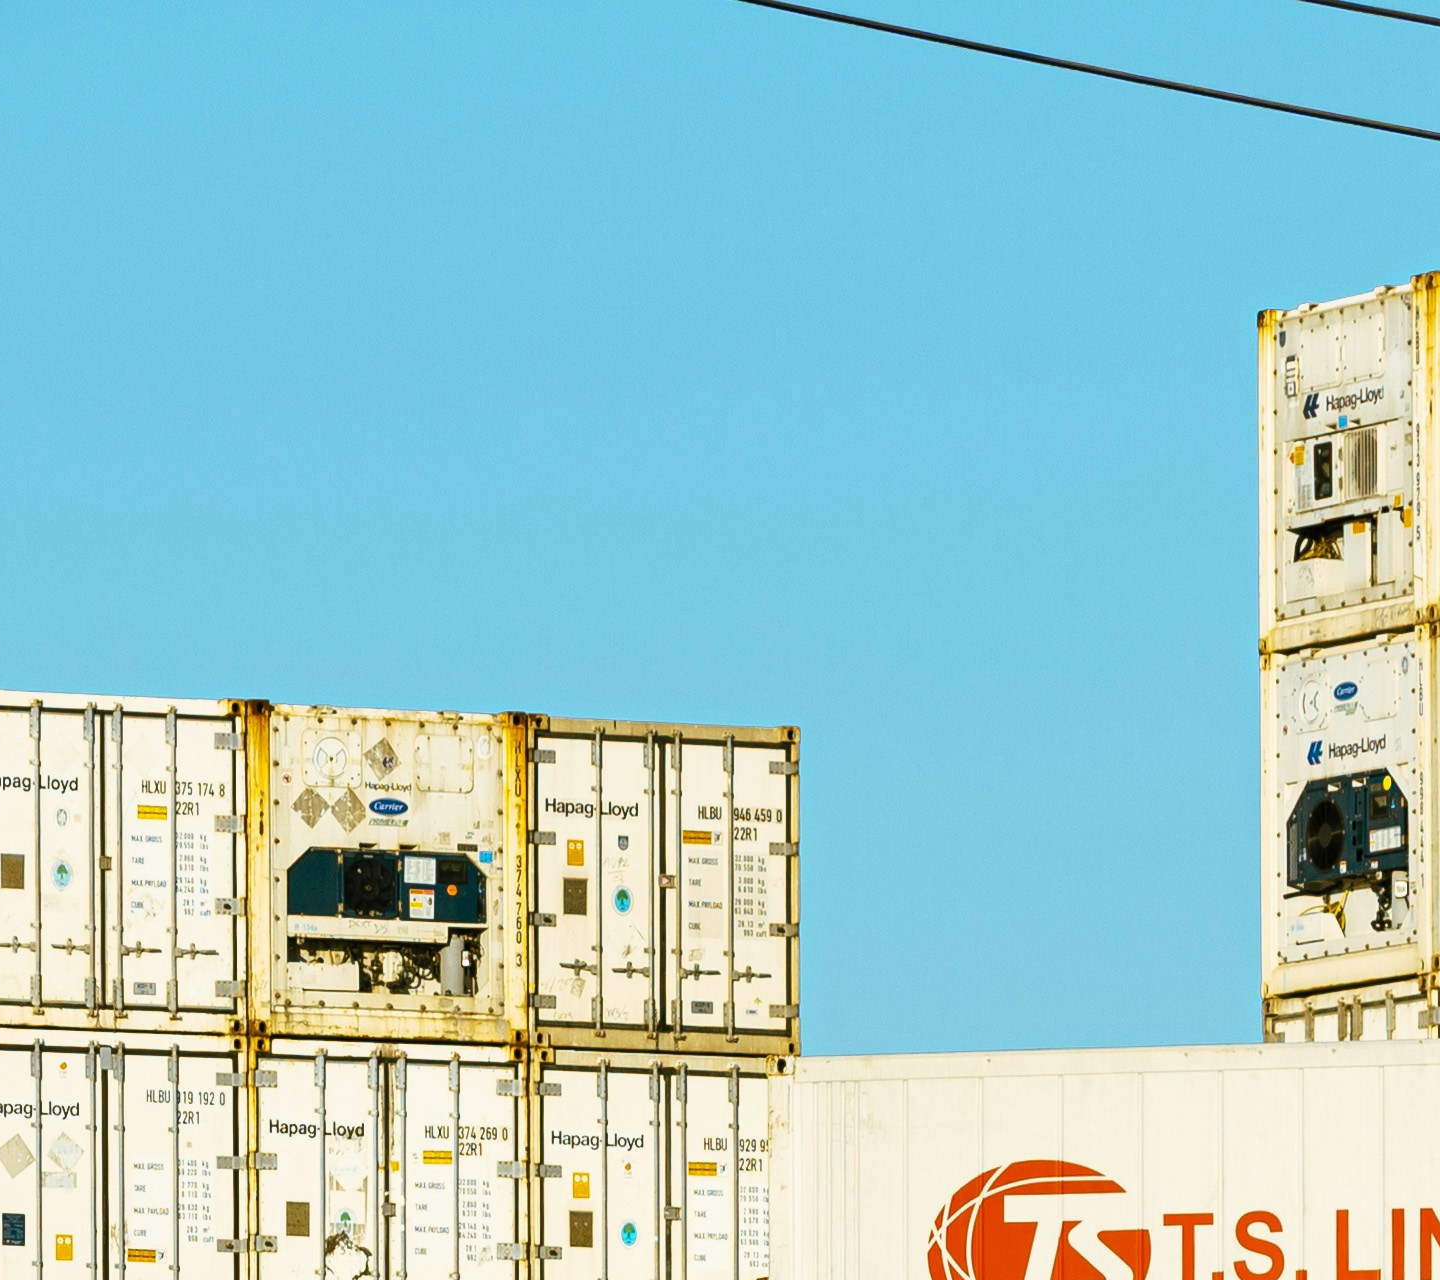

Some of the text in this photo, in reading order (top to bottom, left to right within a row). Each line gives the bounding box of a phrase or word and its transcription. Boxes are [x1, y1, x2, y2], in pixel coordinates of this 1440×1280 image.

[1326, 385, 1385, 412] Hapag-Lloyd
[1335, 685, 1357, 697] Carrier
[1328, 734, 1386, 759] Hapag-Lloyd
[372, 800, 405, 814] Carrier
